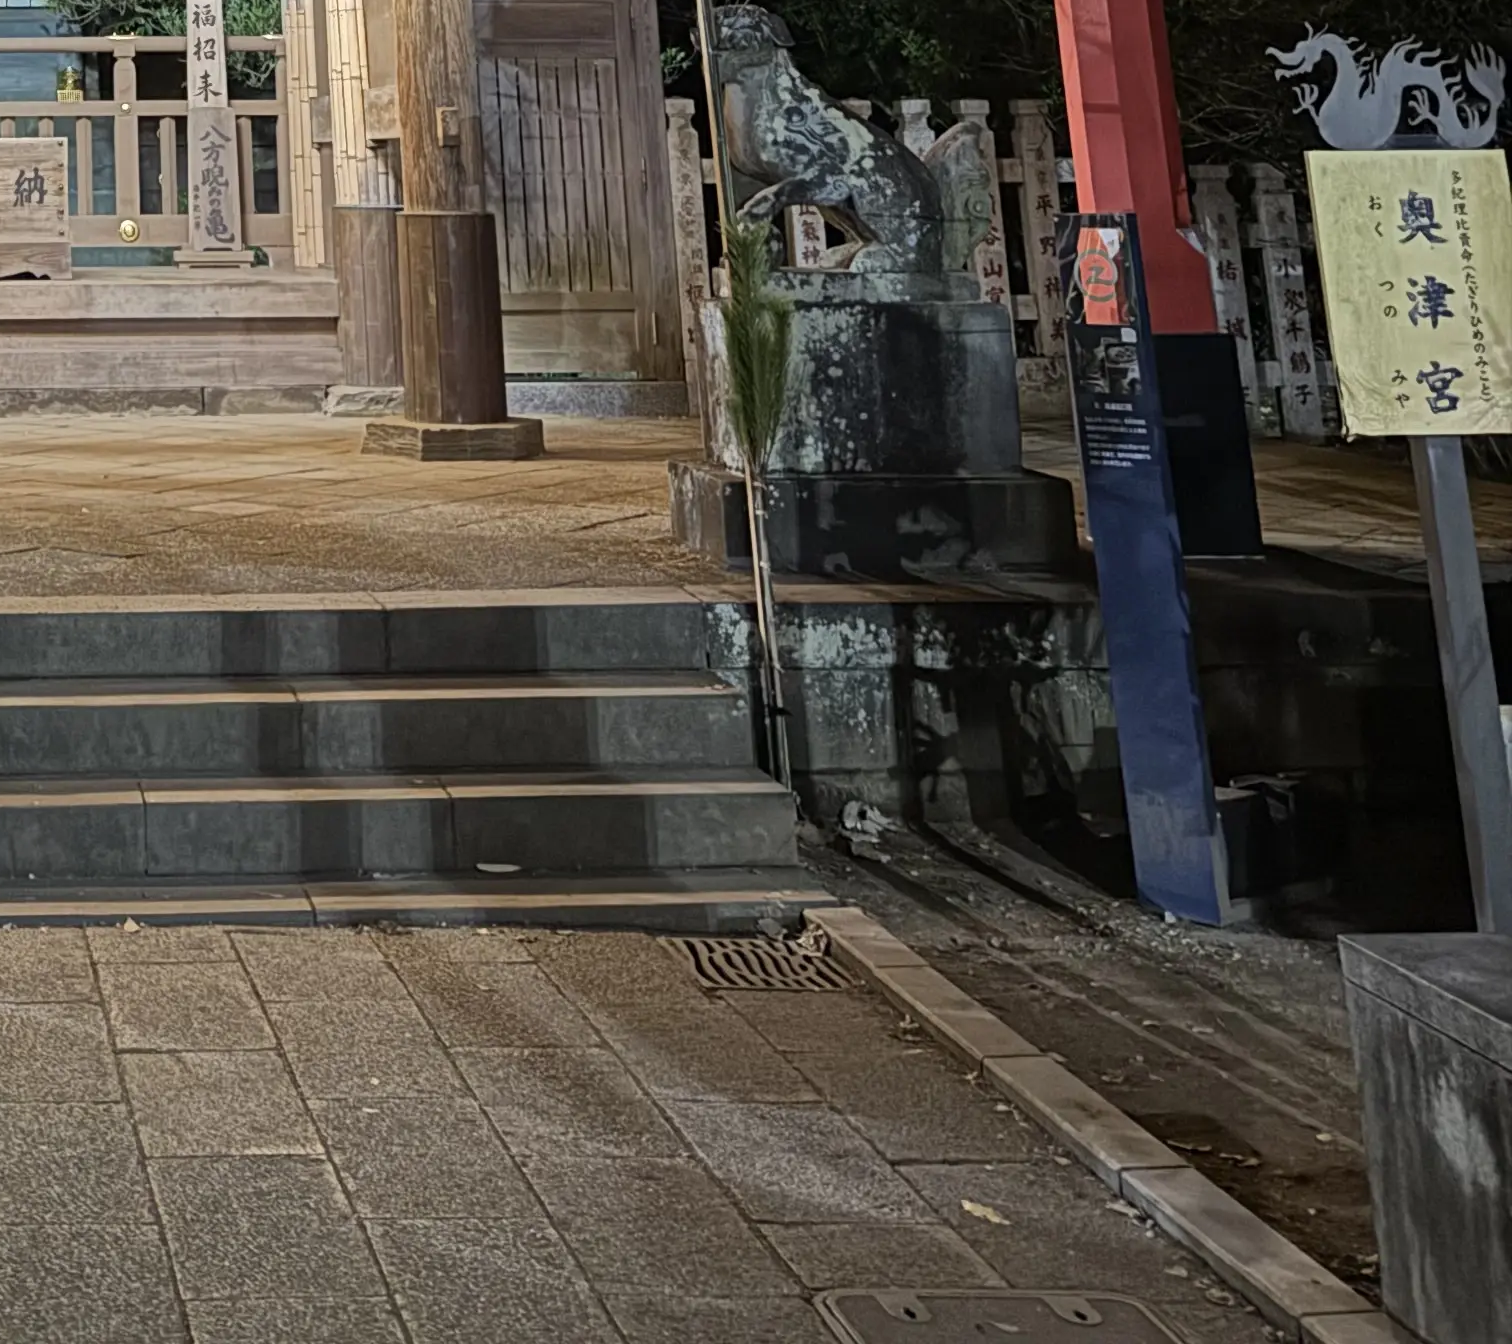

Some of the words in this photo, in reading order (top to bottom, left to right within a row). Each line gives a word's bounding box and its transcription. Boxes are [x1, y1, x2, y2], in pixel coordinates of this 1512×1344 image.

[199, 125, 235, 243] 八方睨みの亀
[1396, 189, 1464, 414] 奥津宮
